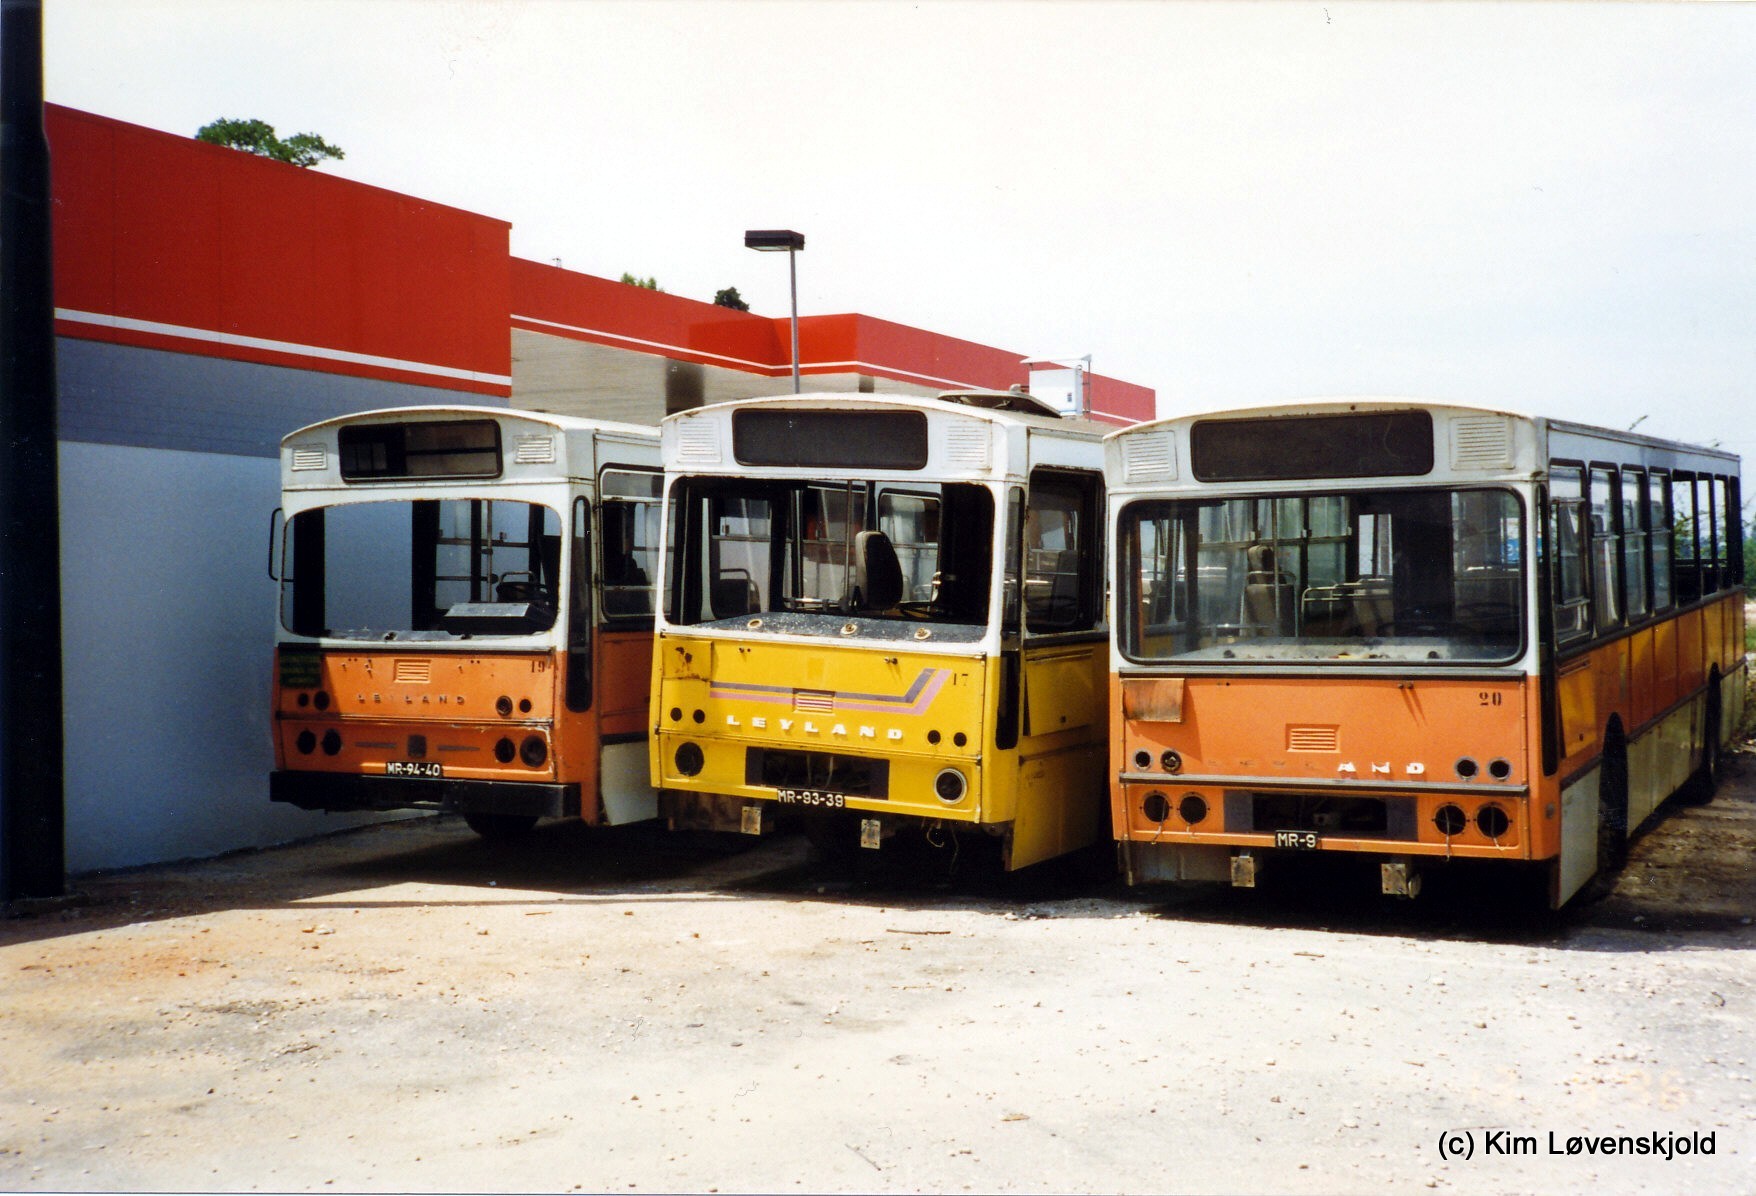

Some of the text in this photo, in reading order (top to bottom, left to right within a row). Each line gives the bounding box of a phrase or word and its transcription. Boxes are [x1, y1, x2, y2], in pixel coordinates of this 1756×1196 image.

[358, 693, 465, 706] LELAND
[1479, 692, 1501, 706] 20
[726, 715, 903, 739] LEYLAND
[387, 762, 440, 776] MR-94-40
[777, 790, 844, 807] MR-93-39
[1277, 833, 1316, 848] MR-9
